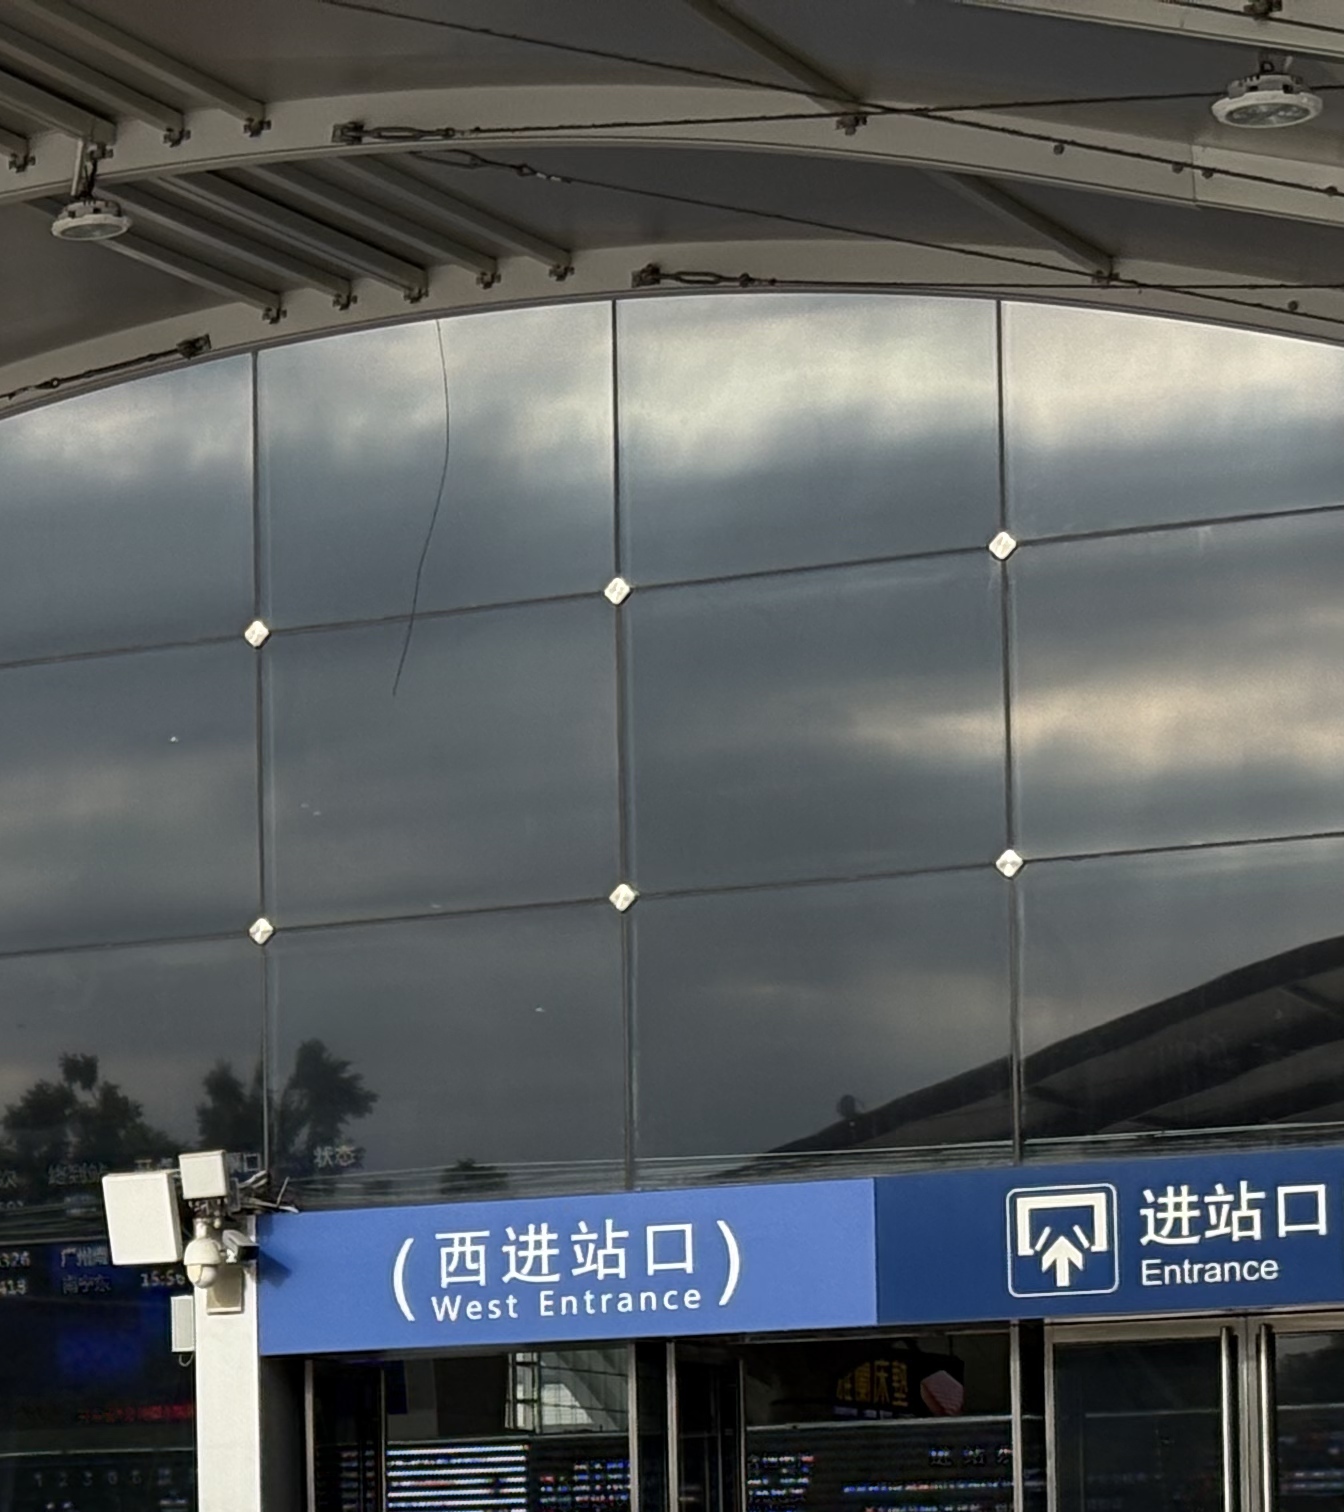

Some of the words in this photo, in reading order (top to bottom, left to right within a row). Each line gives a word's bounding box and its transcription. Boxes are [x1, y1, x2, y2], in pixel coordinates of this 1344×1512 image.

[1139, 1180, 1328, 1247] 进站口
[1141, 1258, 1280, 1287] Entrance
[431, 1293, 520, 1322] West
[539, 1285, 702, 1317] Entrance
